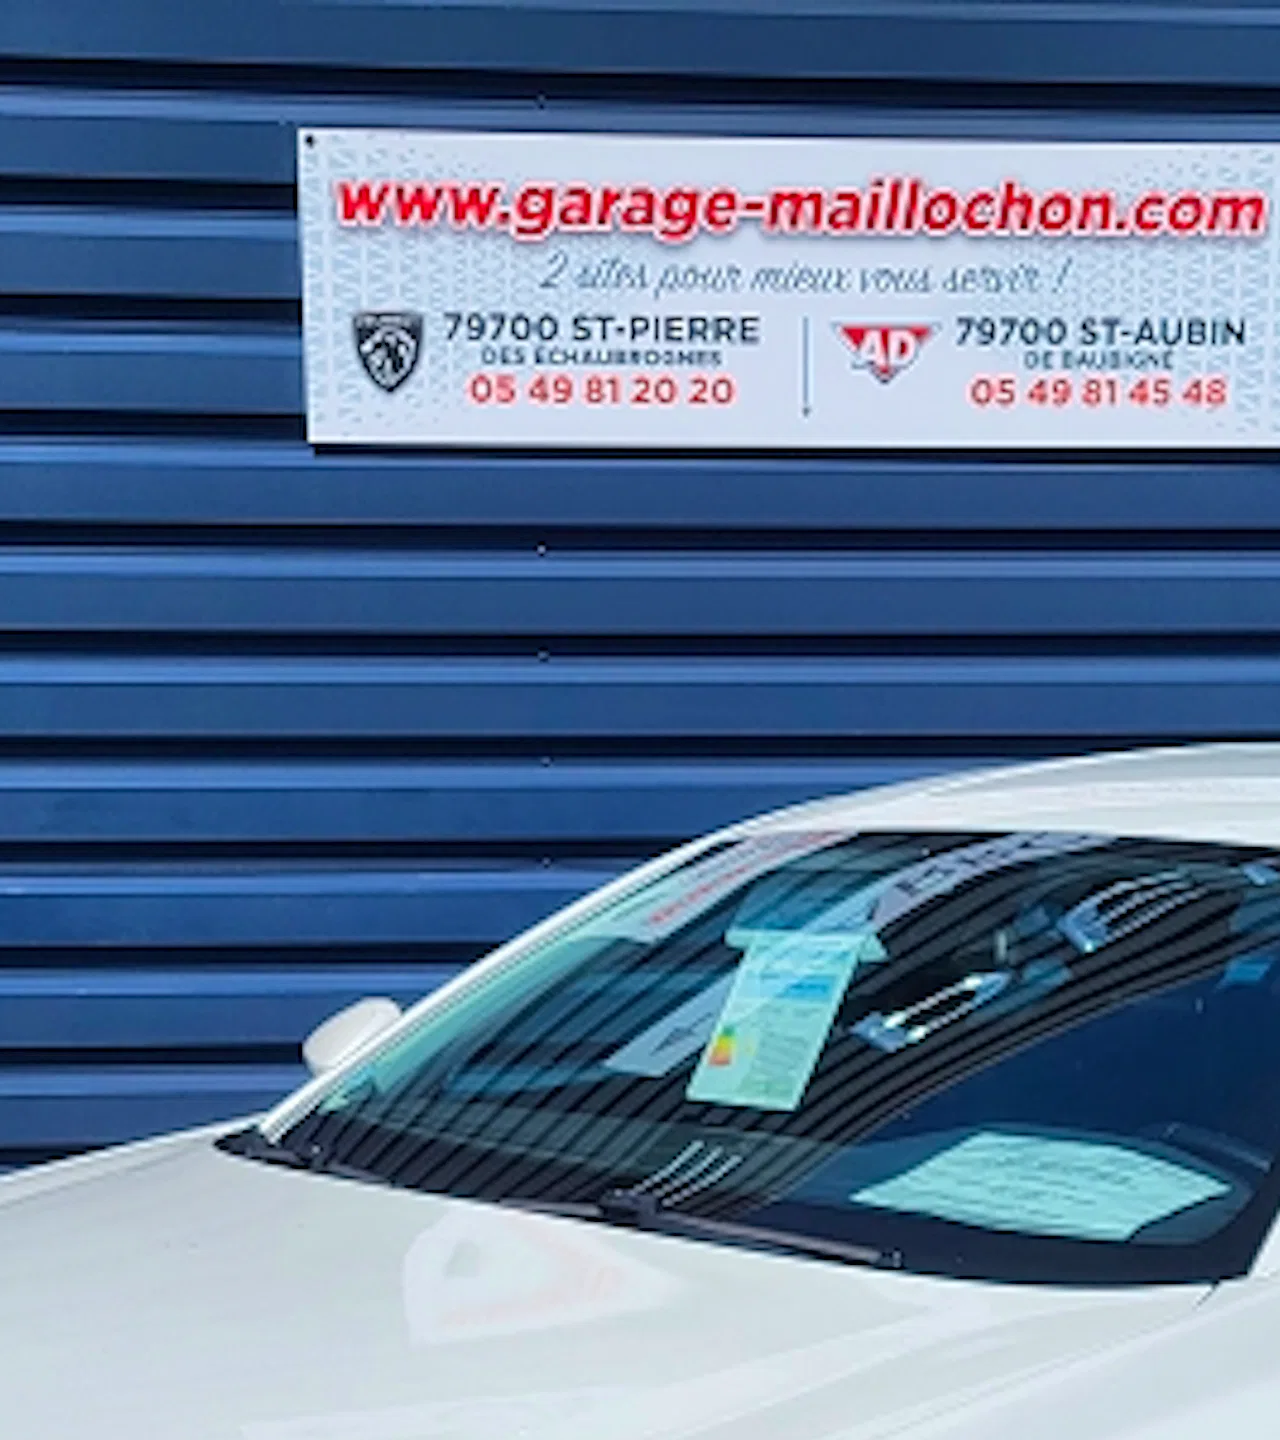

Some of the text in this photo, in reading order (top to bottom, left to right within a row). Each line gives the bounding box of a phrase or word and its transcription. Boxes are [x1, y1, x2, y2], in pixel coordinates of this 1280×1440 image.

[337, 178, 1267, 240] www.garage-maillochon.com
[539, 250, 569, 288] 2
[575, 256, 649, 289] sites
[652, 264, 742, 300] pour
[750, 260, 851, 292] mieux
[859, 264, 930, 293] vous
[942, 263, 1039, 293] servir
[444, 313, 559, 341] 79700
[572, 315, 761, 343] ST-PIERRE
[955, 316, 1246, 346] 79700 ST-AUBIN
[481, 348, 525, 366] DES
[857, 328, 918, 365] AD
[1024, 350, 1053, 370] DE
[470, 374, 735, 405] 05 49 81 20 20
[970, 377, 1229, 407] 05 49 81 45 48
